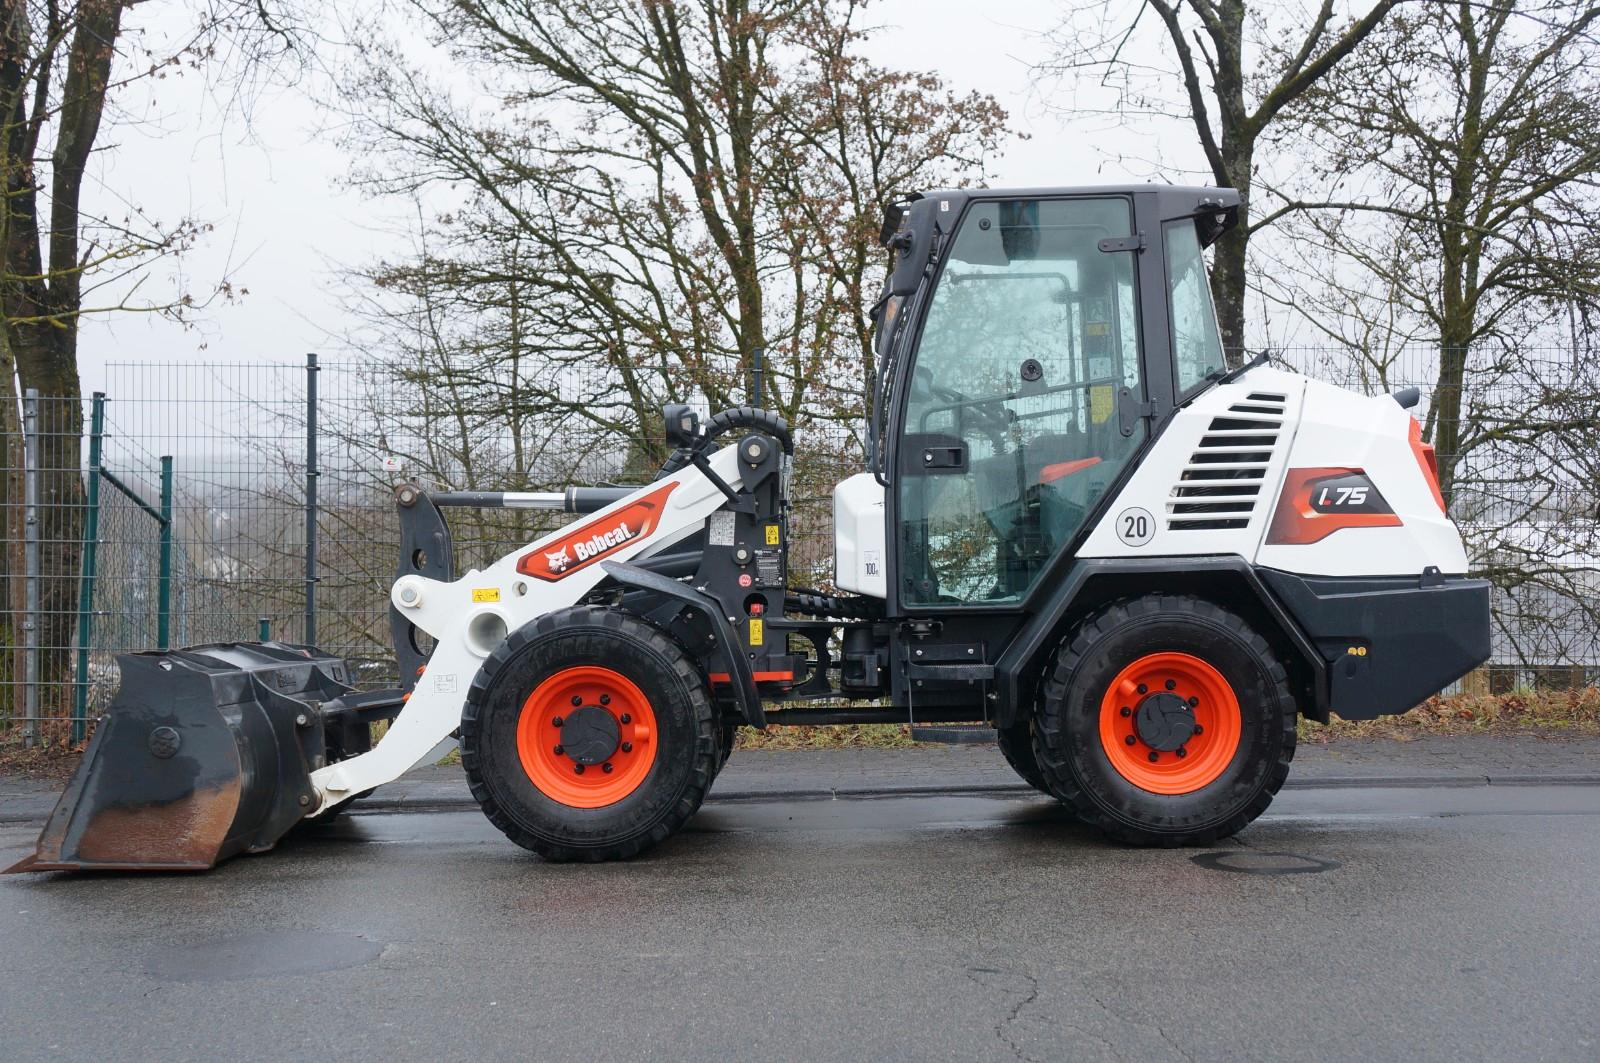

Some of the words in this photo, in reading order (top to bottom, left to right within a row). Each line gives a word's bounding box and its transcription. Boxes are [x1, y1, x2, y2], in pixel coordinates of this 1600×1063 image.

[1124, 515, 1147, 539] 20
[573, 522, 632, 561] Bobcat
[865, 562, 875, 575] 100
